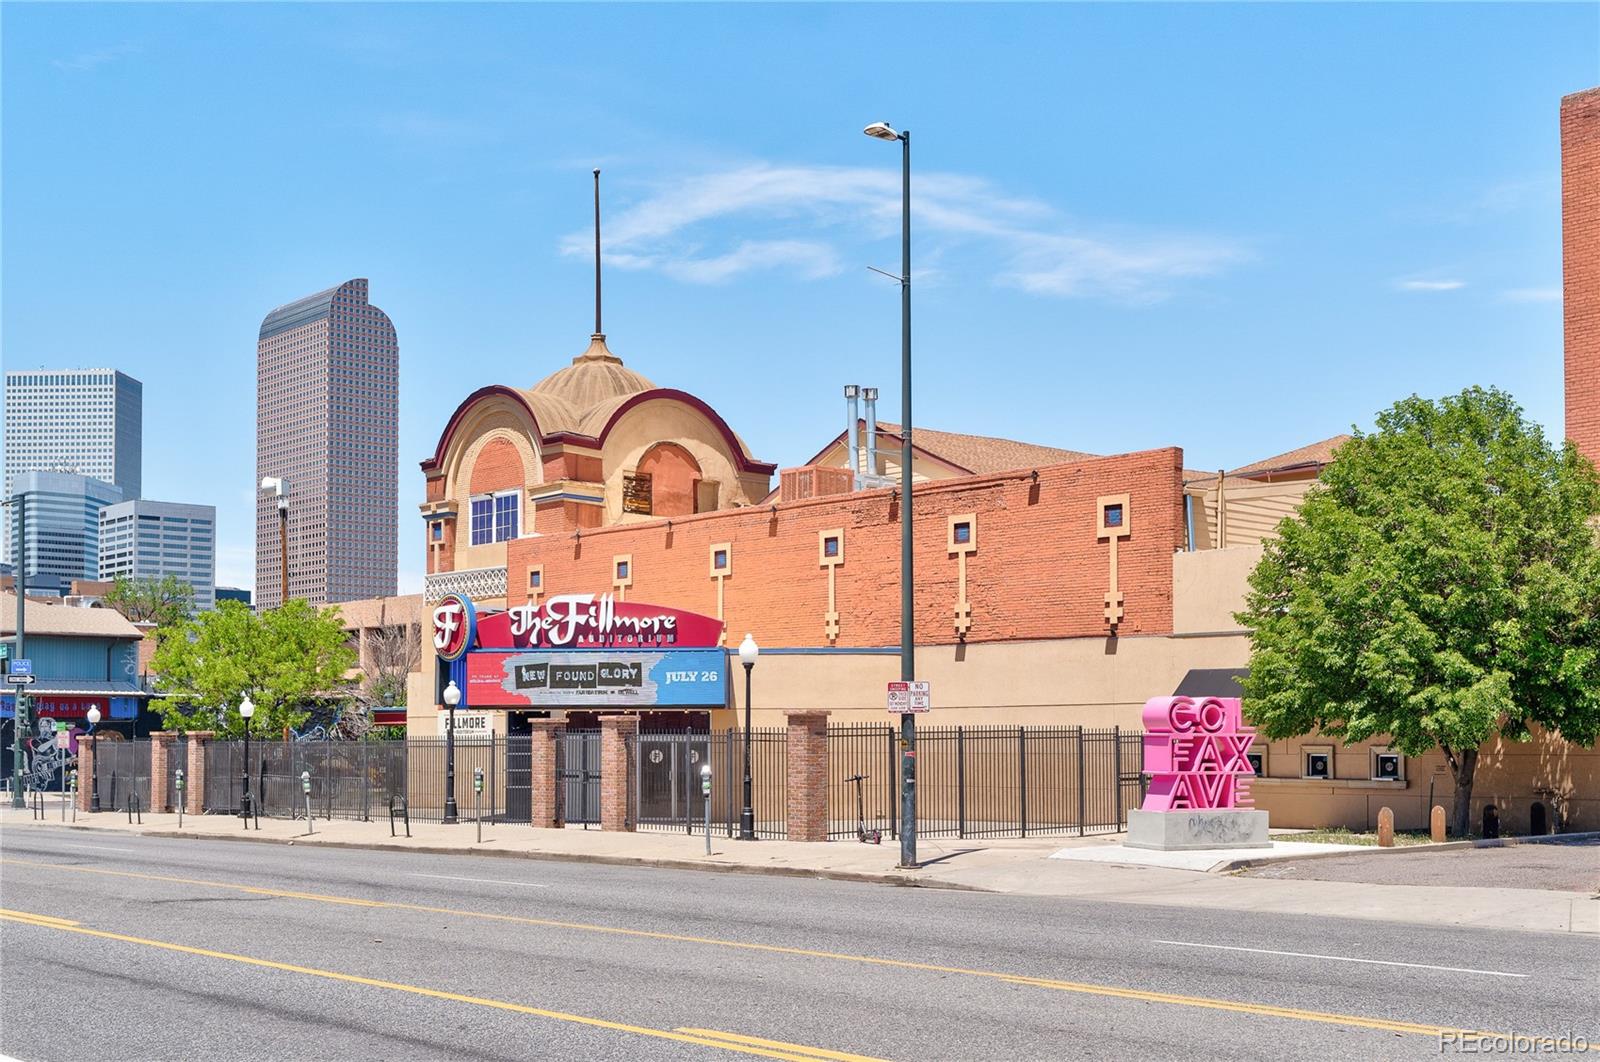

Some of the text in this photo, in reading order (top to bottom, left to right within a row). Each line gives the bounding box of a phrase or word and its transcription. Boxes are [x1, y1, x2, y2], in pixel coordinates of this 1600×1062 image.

[433, 603, 462, 649] F
[508, 592, 677, 645] The Fillmore
[577, 634, 675, 644] AUDITORIUM
[521, 665, 638, 682] NEW FOUND GLORY
[665, 671, 718, 684] JULY 26
[445, 717, 486, 729] FLLMORE
[1170, 733, 1256, 773] FAX
[1167, 773, 1256, 811] AVE
